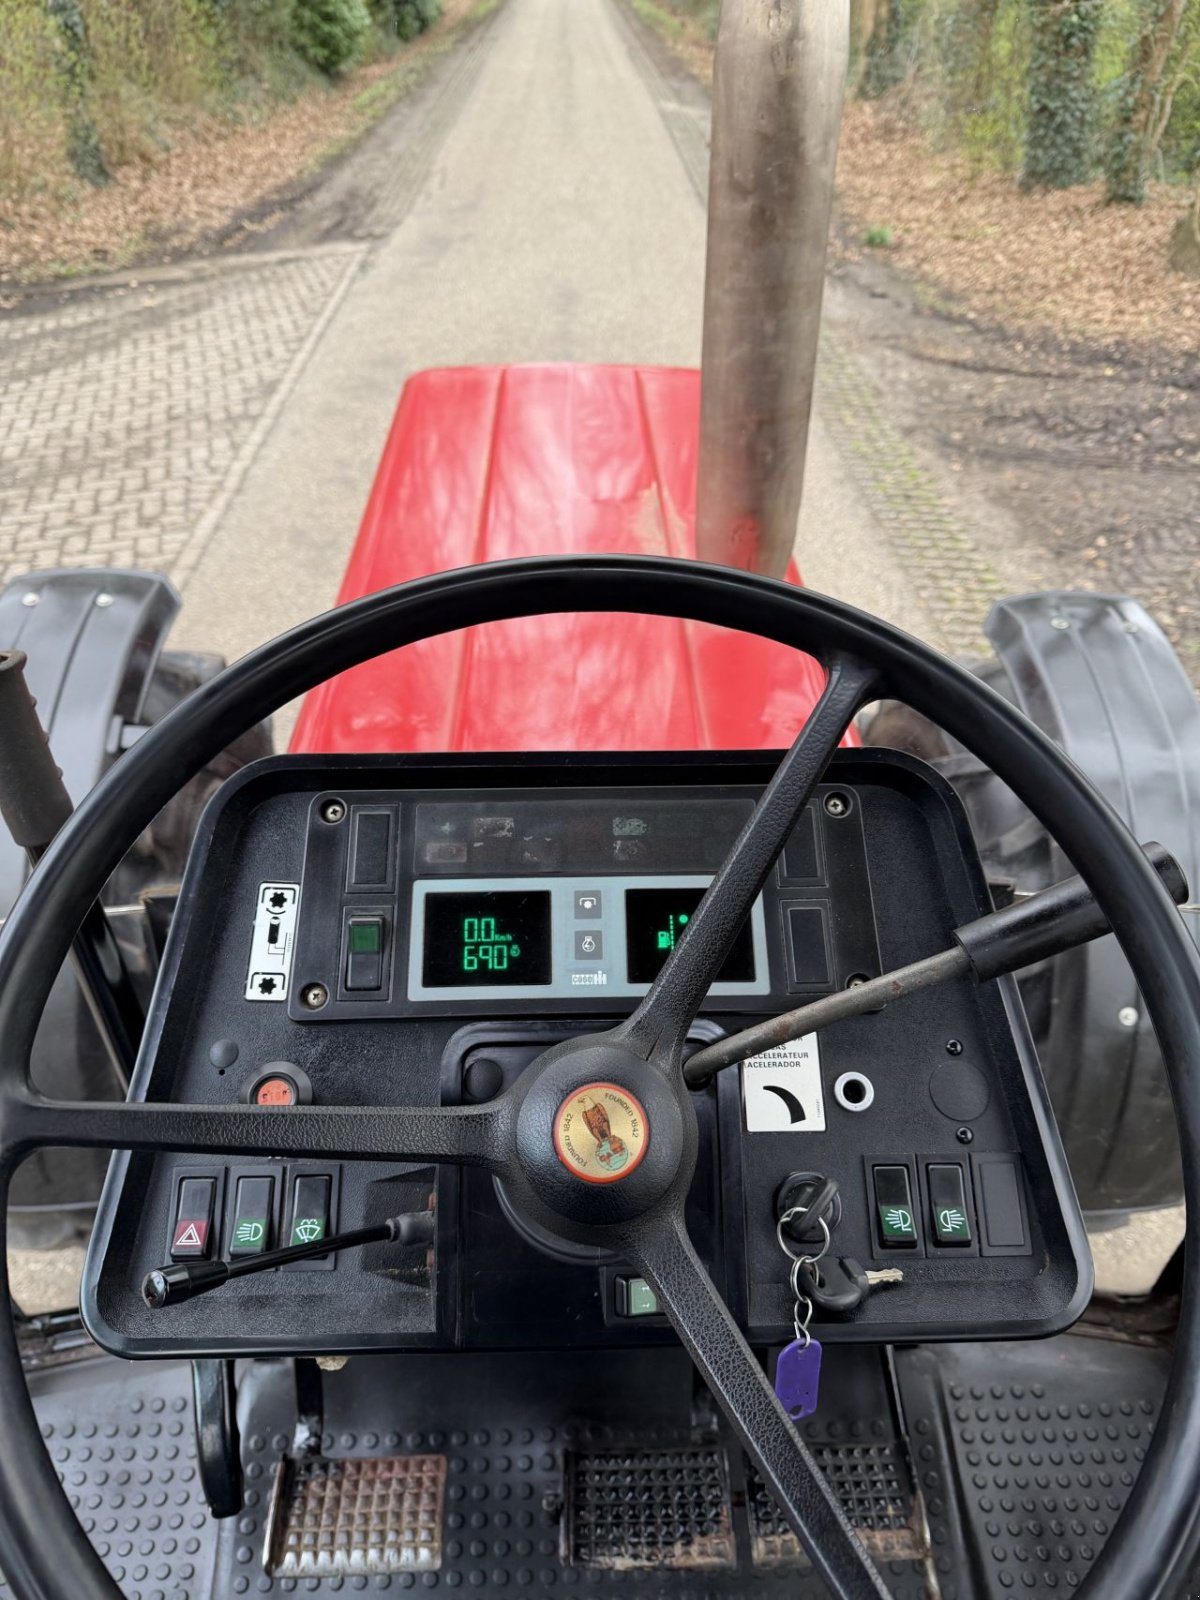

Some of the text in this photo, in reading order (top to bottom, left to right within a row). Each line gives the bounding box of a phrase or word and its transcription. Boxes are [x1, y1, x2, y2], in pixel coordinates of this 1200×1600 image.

[464, 918, 495, 942] 0.0
[464, 945, 507, 970] 690
[749, 1052, 809, 1060] CCELERATEUR
[563, 1113, 573, 1131] 1842
[630, 1118, 639, 1138] 1842
